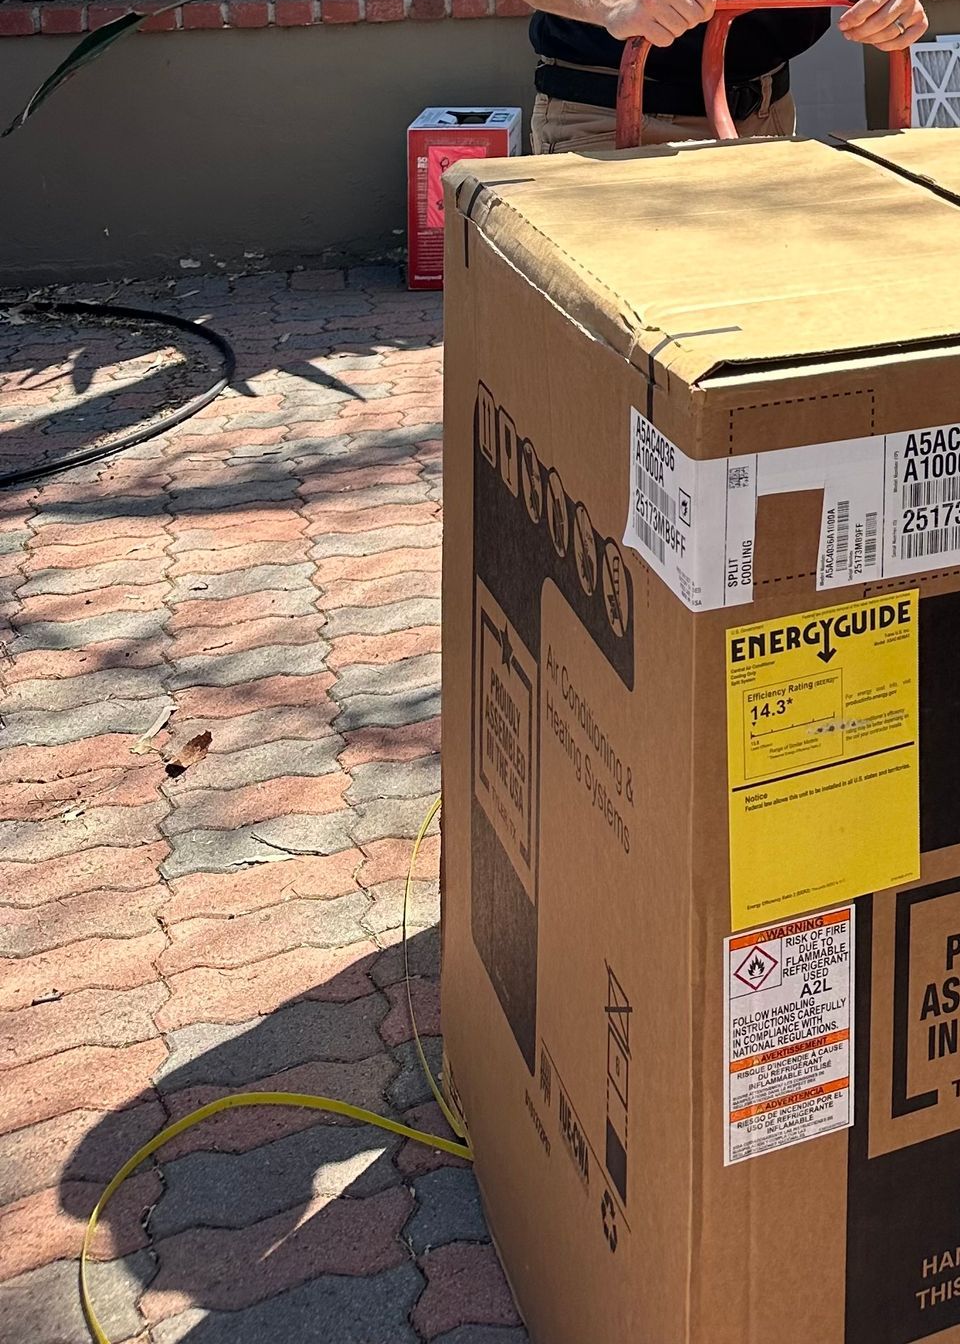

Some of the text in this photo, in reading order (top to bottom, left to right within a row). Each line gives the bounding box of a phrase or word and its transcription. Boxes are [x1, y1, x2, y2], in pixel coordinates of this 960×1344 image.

[636, 416, 675, 471] A5AC4036
[636, 444, 664, 487] A1000A
[635, 488, 686, 558] 25173MB9FF
[826, 508, 836, 578] A5AC4036A1000A
[854, 523, 864, 574] 25173MB9FF
[728, 558, 738, 588] SPLIT
[741, 540, 752, 585] COOLING
[731, 600, 911, 663] ENERGYGUIDE
[748, 687, 786, 702] Efficiency
[789, 682, 813, 693] Rating
[546, 643, 634, 808] Air Conditioning &
[546, 689, 630, 854] Heating Systems
[745, 803, 763, 812] Federal
[773, 797, 788, 805] allows
[799, 790, 808, 798] unit
[822, 782, 841, 792] installed
[864, 773, 878, 781] states
[745, 793, 768, 804] Notice
[766, 917, 824, 938] WARNING
[786, 923, 846, 947] RISK OF FIRE
[786, 943, 846, 967] FLAMMABLE
[799, 936, 833, 954] DUE TO
[783, 952, 848, 978] REFRIGERANT
[804, 968, 829, 982] USED
[800, 978, 832, 998] A2L
[733, 997, 815, 1028] FOLLOW HANDLING
[733, 998, 846, 1037] INSTRUCTIONS CAREFULLY
[733, 1015, 822, 1049] IN COMPLIANCE WITH
[733, 1021, 839, 1058] NATIONAL REGULATIONS.
[928, 1020, 958, 1061] IN
[737, 1066, 765, 1080] RISQUE
[767, 1052, 809, 1070] D'INCENDIE
[818, 1043, 843, 1056] CAUSE
[761, 1037, 828, 1062] AVERTISSEMENT
[749, 1069, 802, 1091] INFLAMMABLE
[737, 1115, 765, 1129] RIESGO
[768, 1111, 777, 1119] DE
[780, 1100, 815, 1116] INCENDIO
[817, 1095, 832, 1105] POR
[766, 1086, 824, 1110] ADVERTENCIA
[747, 1101, 834, 1133] USO DE REFRIGERANTE
[767, 1116, 813, 1134] INFLAMABLE
